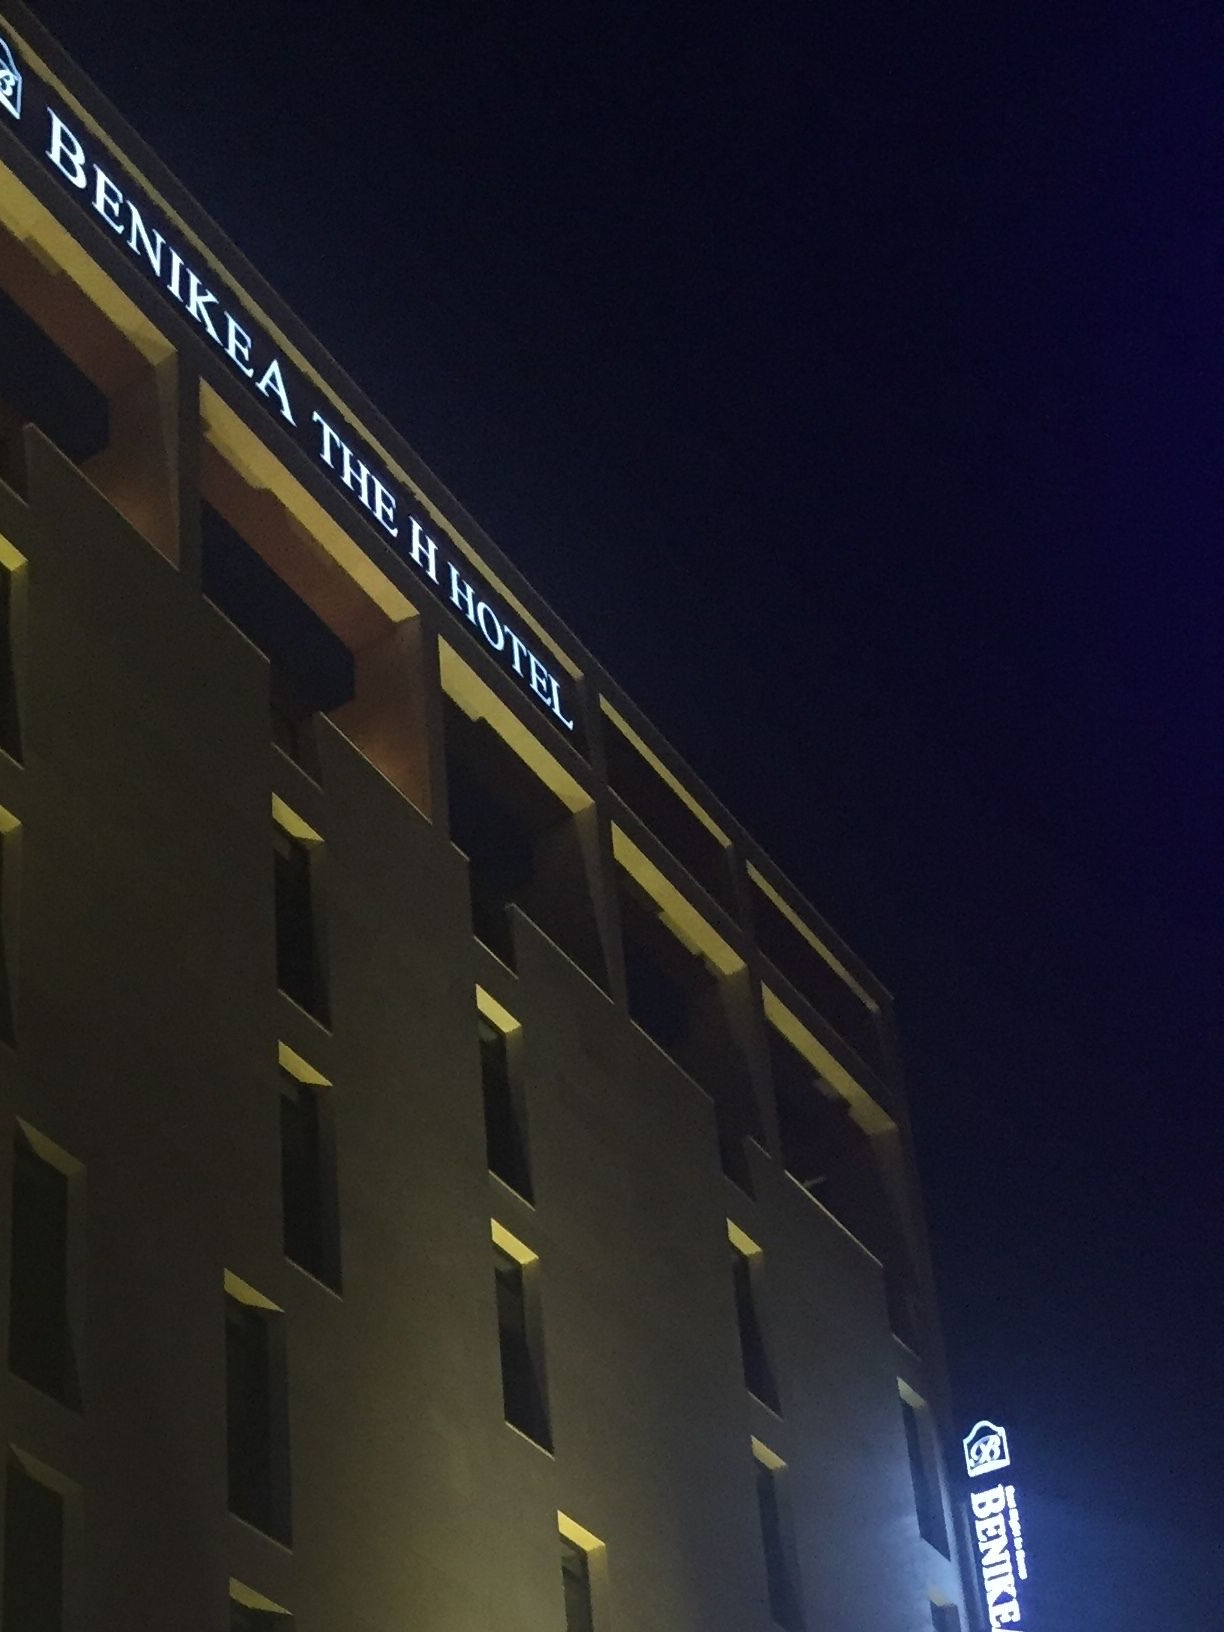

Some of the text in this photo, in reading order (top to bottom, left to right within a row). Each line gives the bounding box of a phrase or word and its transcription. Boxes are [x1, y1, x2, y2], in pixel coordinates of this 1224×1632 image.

[45, 106, 573, 731] BENIKEA THE H HOTEL
